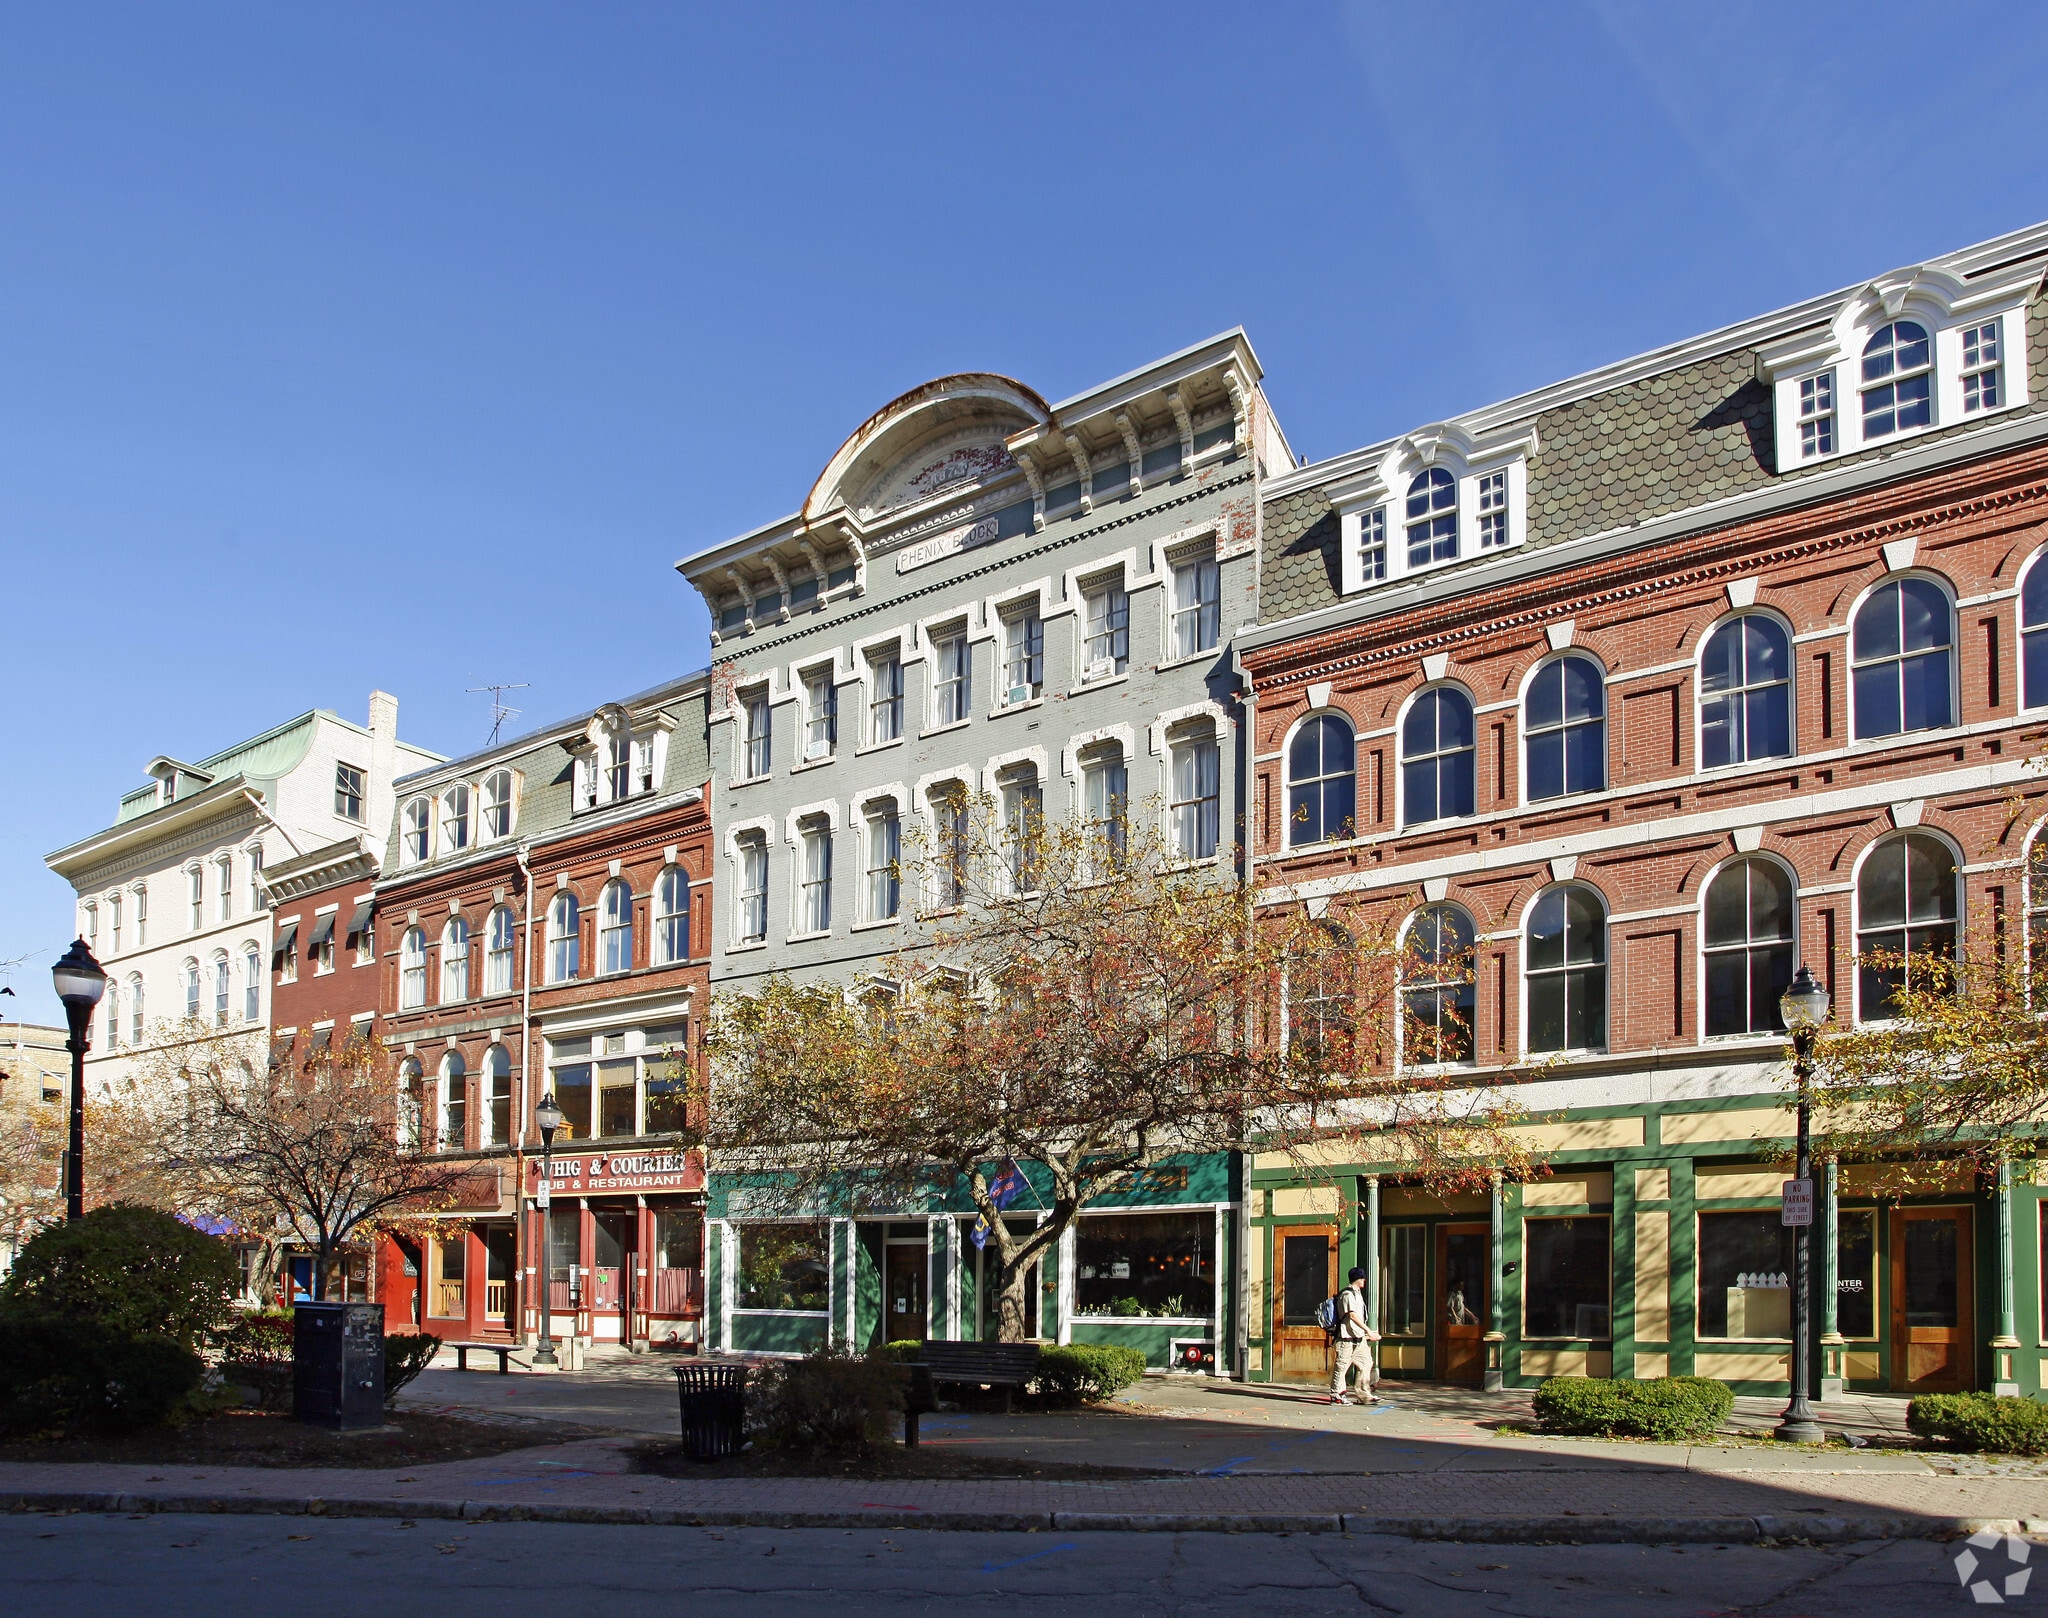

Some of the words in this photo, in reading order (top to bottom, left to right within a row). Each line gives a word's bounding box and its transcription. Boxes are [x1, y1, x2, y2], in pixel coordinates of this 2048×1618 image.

[901, 541, 945, 569] PHENIX
[952, 523, 993, 548] BLOCK
[589, 1157, 602, 1176] &
[610, 1152, 686, 1175] COURIER
[549, 1180, 566, 1190] UB
[572, 1179, 582, 1189] &
[588, 1174, 684, 1189] RESTAURANT
[1792, 1184, 1802, 1193] NO
[1784, 1195, 1810, 1204] PARKING
[1837, 1279, 1862, 1287] NTER
